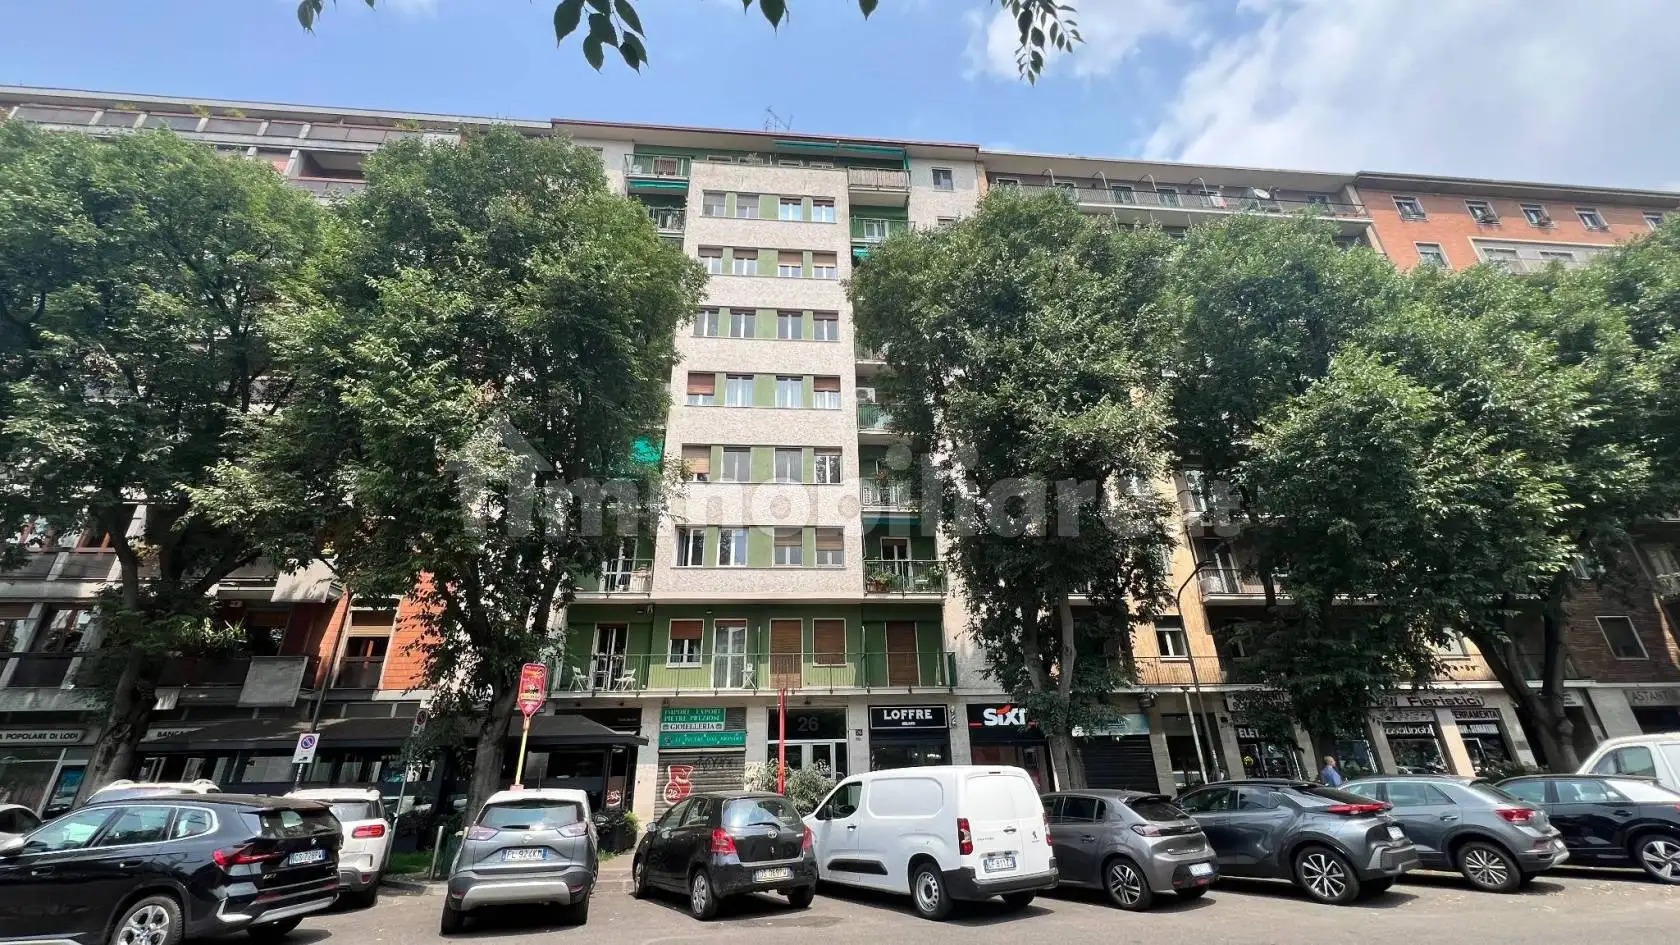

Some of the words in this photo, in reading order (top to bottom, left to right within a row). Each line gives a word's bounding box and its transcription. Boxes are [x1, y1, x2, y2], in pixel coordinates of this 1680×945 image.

[883, 709, 933, 720] LOFFRE
[798, 716, 819, 731] 26
[6, 732, 47, 740] POPOLARE
